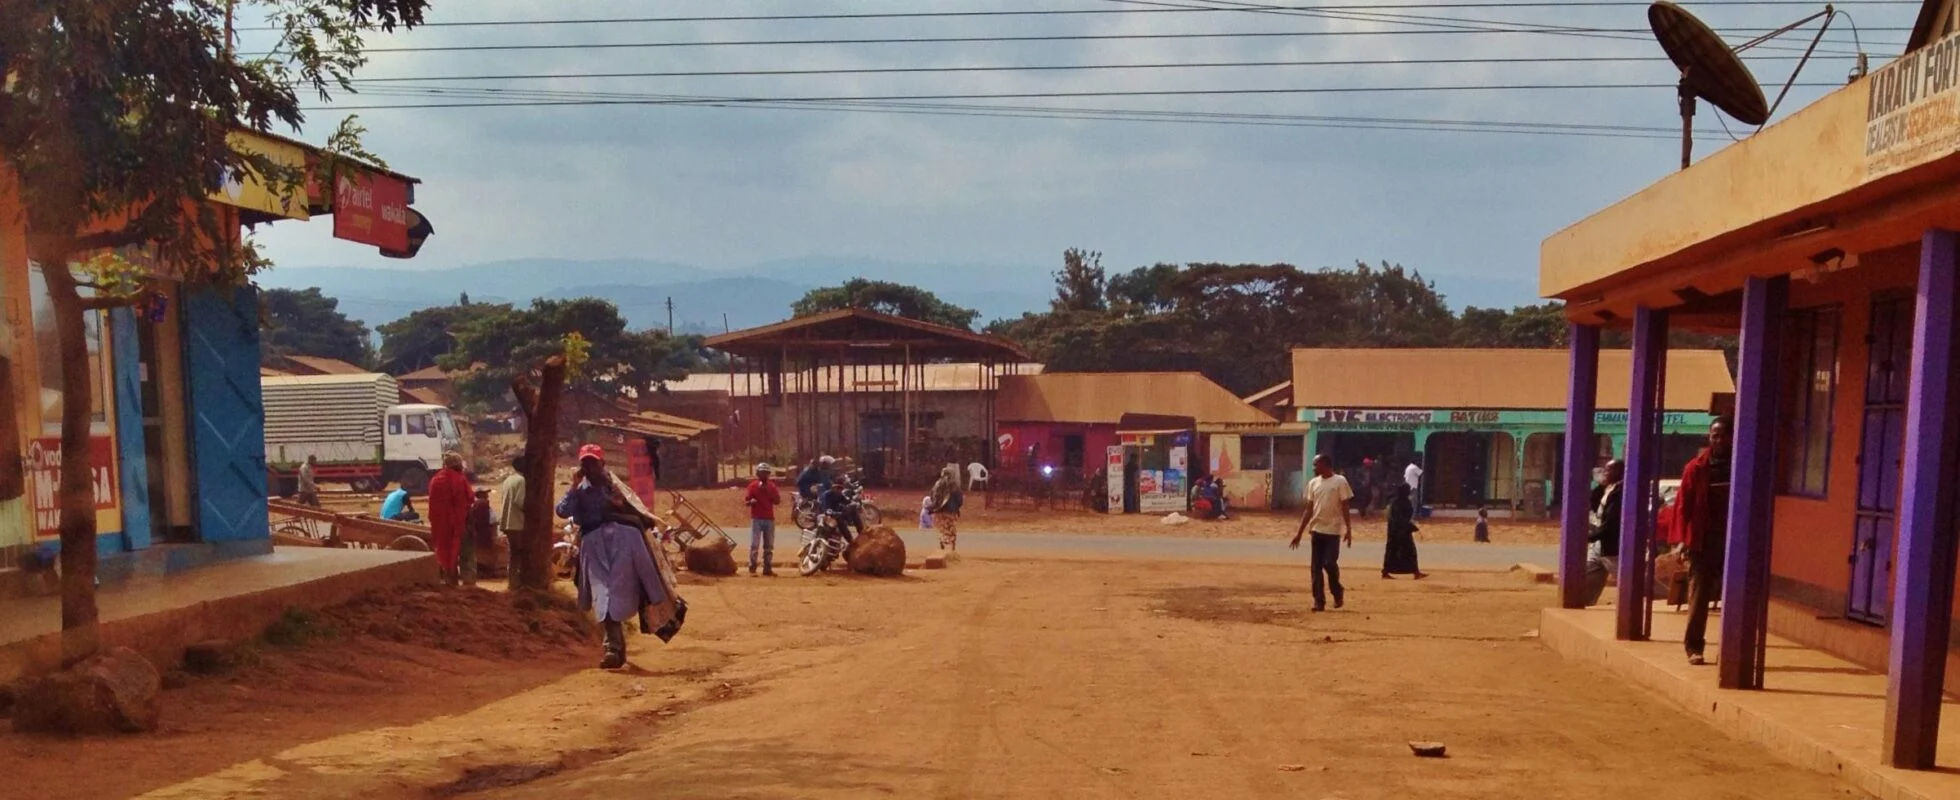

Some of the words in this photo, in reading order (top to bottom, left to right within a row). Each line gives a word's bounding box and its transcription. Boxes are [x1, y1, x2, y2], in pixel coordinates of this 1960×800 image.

[1867, 53, 1920, 123] KARATU
[352, 187, 373, 210] airtel
[381, 202, 406, 225] wakala
[1596, 413, 1629, 423] EMMAN
[1665, 414, 1687, 424] TEL
[35, 467, 112, 508] M-SA
